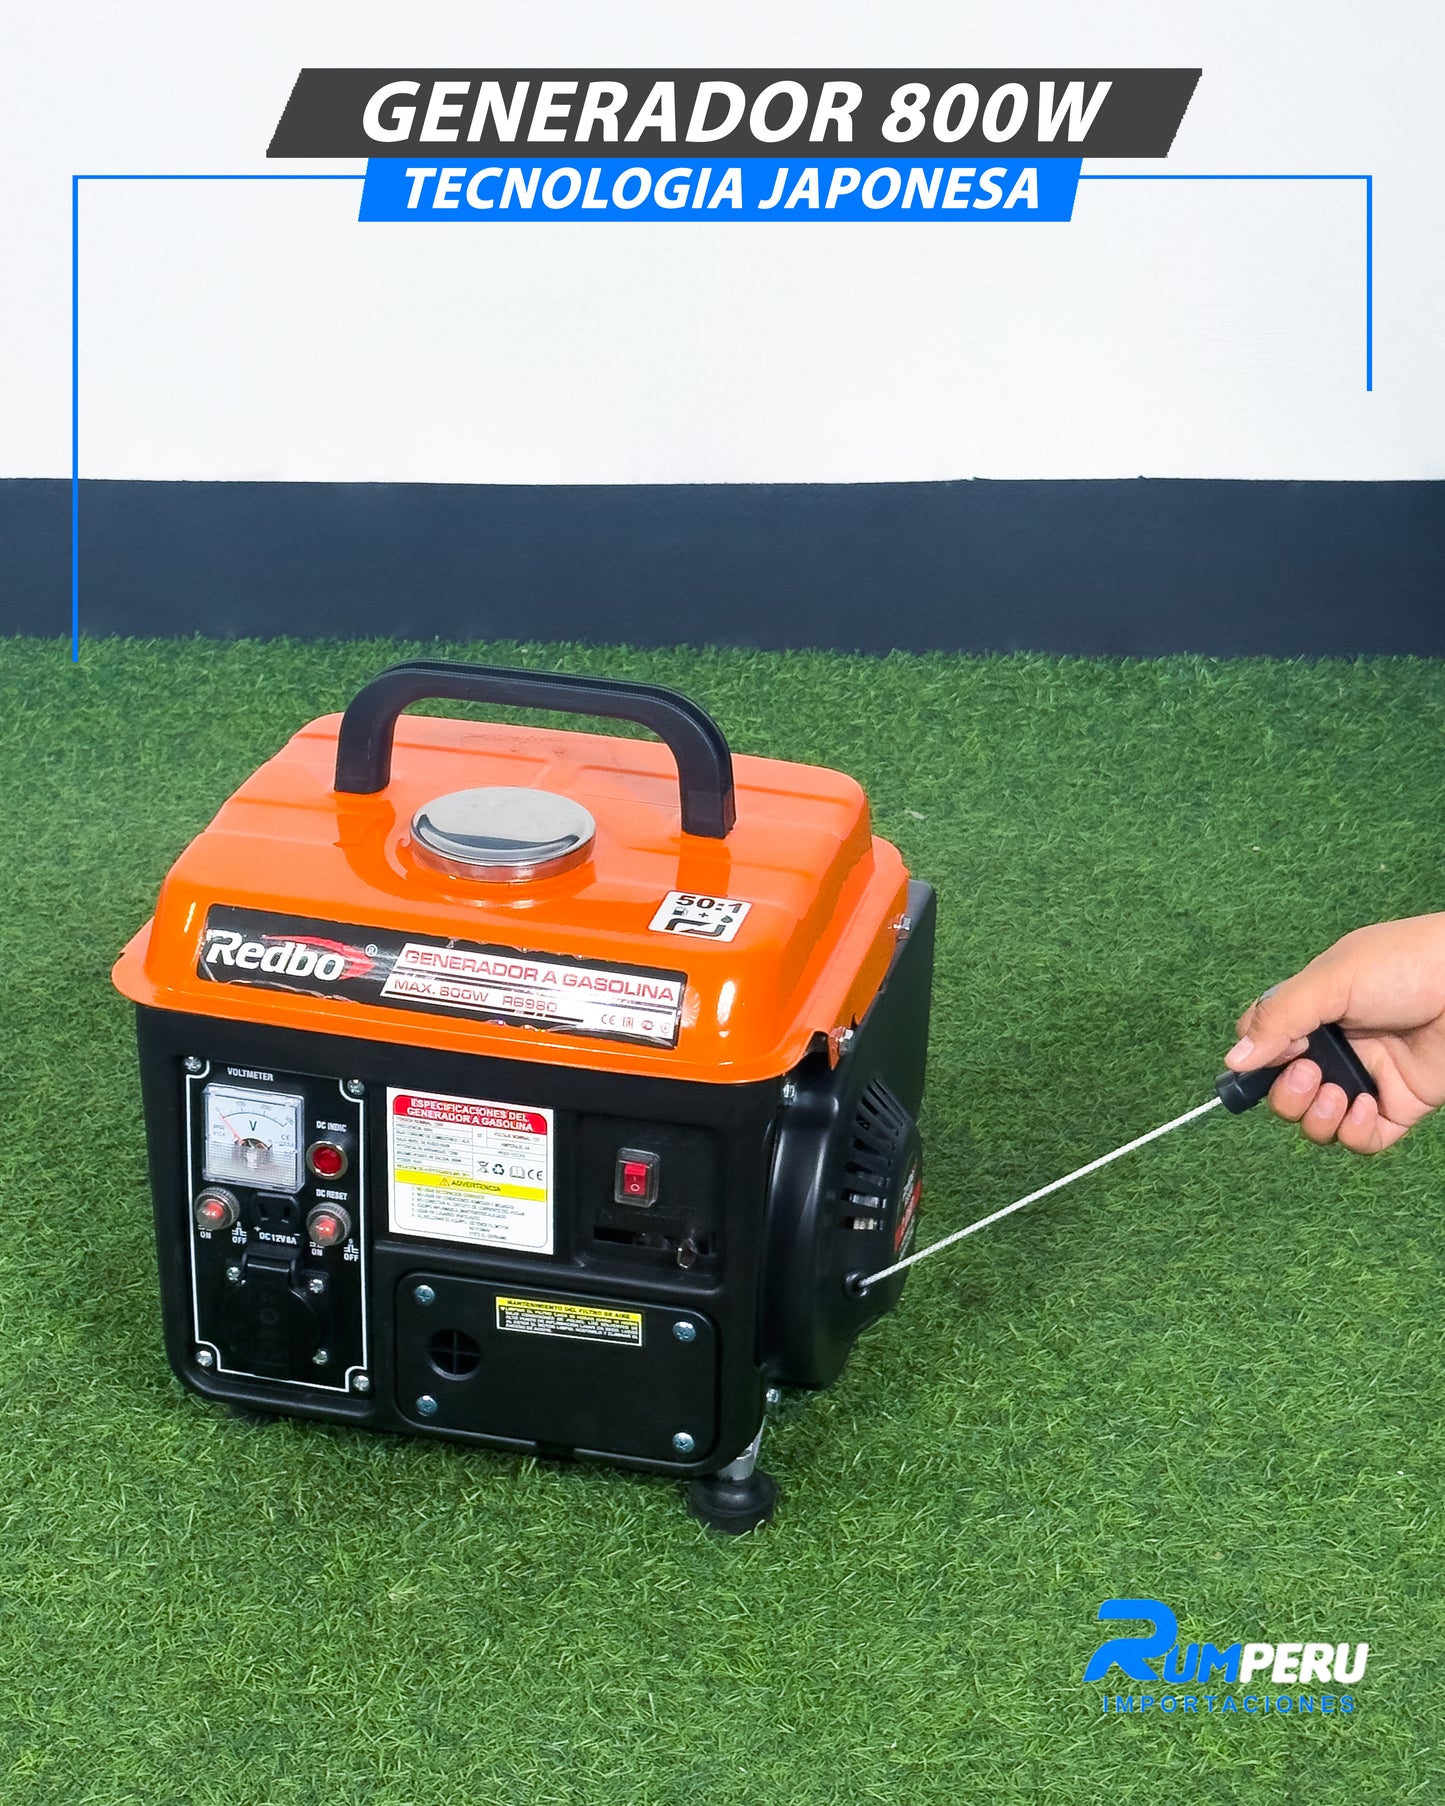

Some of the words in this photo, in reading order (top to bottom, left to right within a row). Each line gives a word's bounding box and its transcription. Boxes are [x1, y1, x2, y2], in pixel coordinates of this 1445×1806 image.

[676, 894, 742, 914] 50:1
[206, 929, 345, 981] Redbo
[404, 949, 539, 982] GENERADOR
[542, 970, 557, 985] A
[562, 973, 675, 1002] GASOLINA
[394, 979, 436, 995] MAX.
[440, 986, 489, 1003] 800W
[227, 1066, 274, 1082] VOLTMETER
[410, 1098, 506, 1119] ESPECIFICACIONES
[509, 1110, 530, 1123] DEL
[249, 1120, 258, 1132] V
[316, 1120, 327, 1130] DC
[406, 1106, 471, 1124] GENERADOR
[471, 1114, 480, 1125] A
[481, 1116, 534, 1132] GASOLINA
[451, 1179, 502, 1193] ADVERTENCIA
[316, 1188, 327, 1198] DC
[327, 1189, 348, 1201] RESET
[200, 1230, 212, 1240] ON
[232, 1235, 248, 1245] OFF
[311, 1247, 323, 1257] ON
[343, 1252, 360, 1263] OFF
